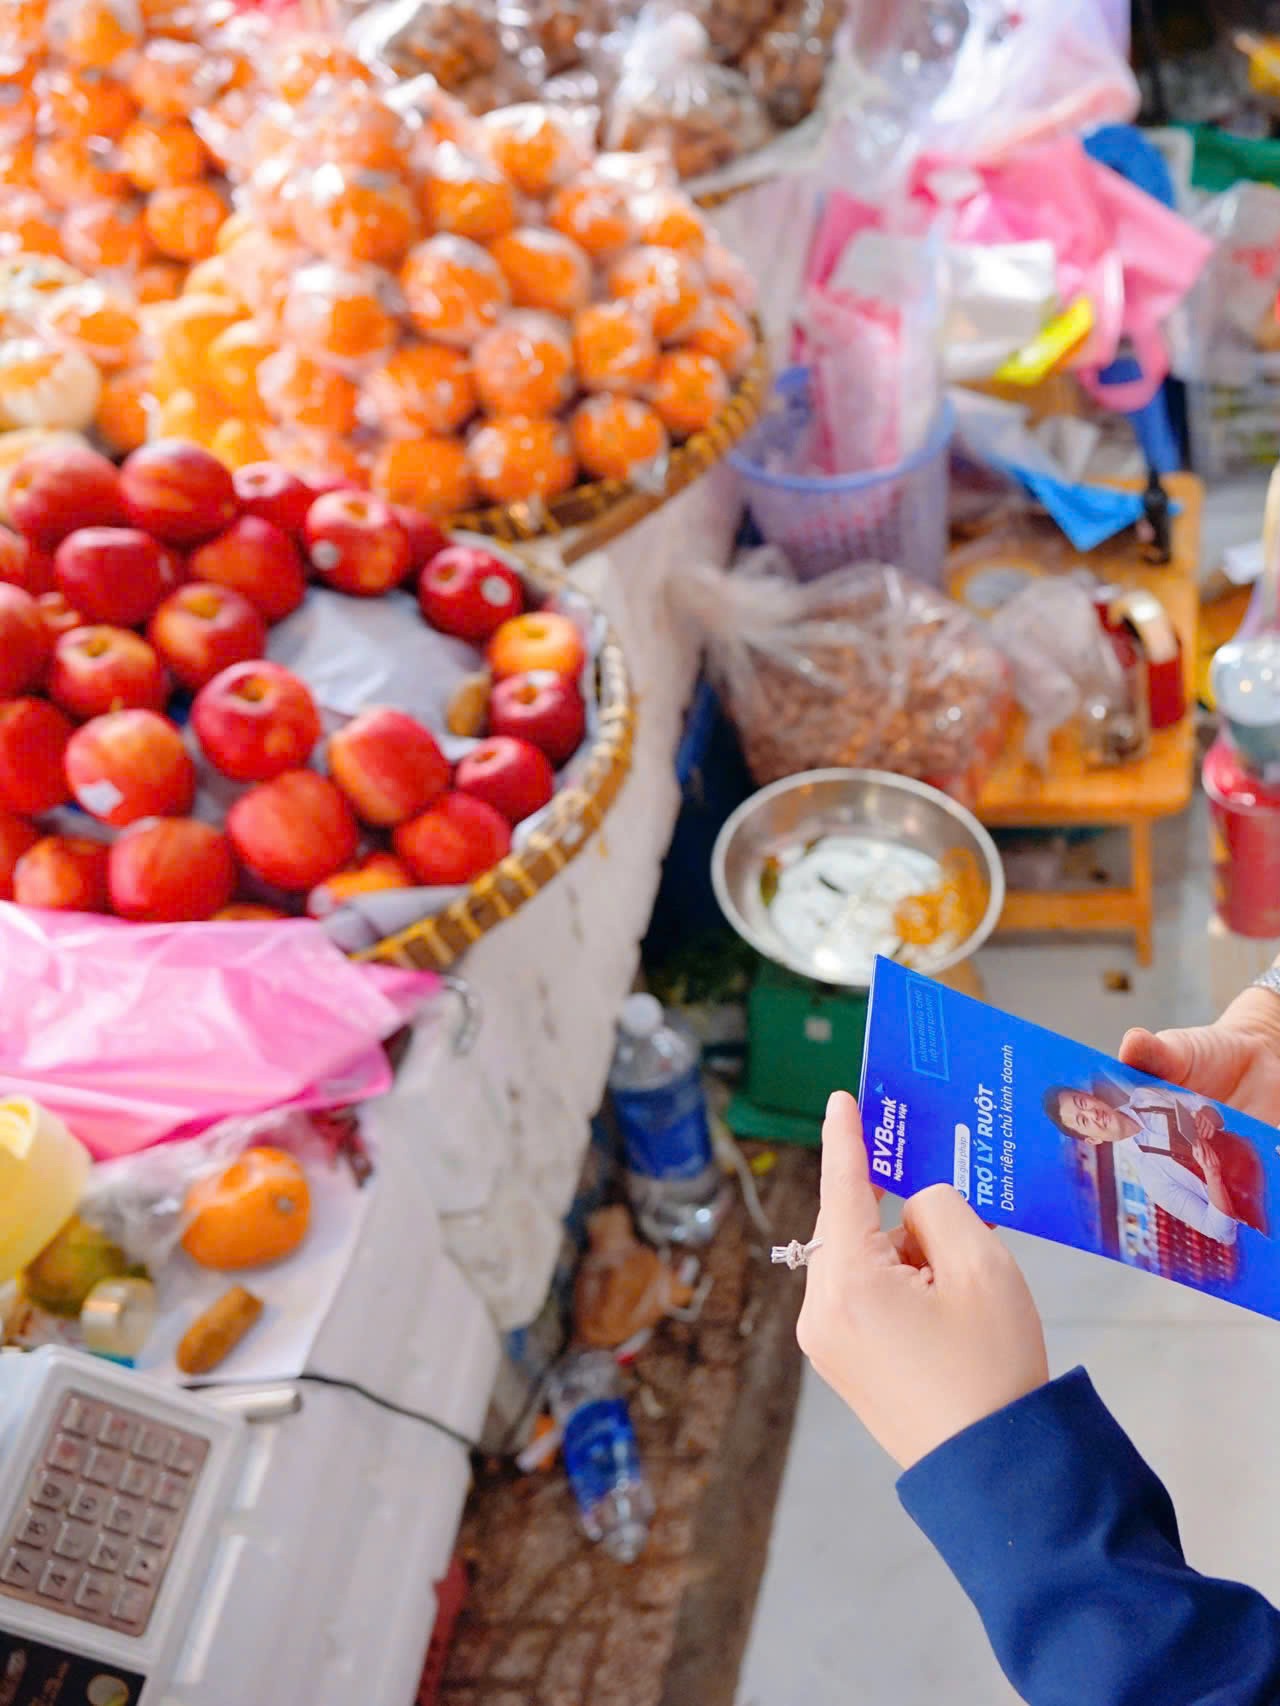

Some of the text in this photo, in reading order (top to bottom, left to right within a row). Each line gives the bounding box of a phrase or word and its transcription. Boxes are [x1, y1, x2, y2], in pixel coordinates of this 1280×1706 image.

[873, 1096, 896, 1177] BVBank
[895, 1137, 906, 1158] hàng
[973, 1083, 998, 1206] TRỢ LÝ RUỘT
[999, 1044, 1016, 1212] Dành riêng chủ kinh doanh
[893, 1159, 904, 1181] Ngân
